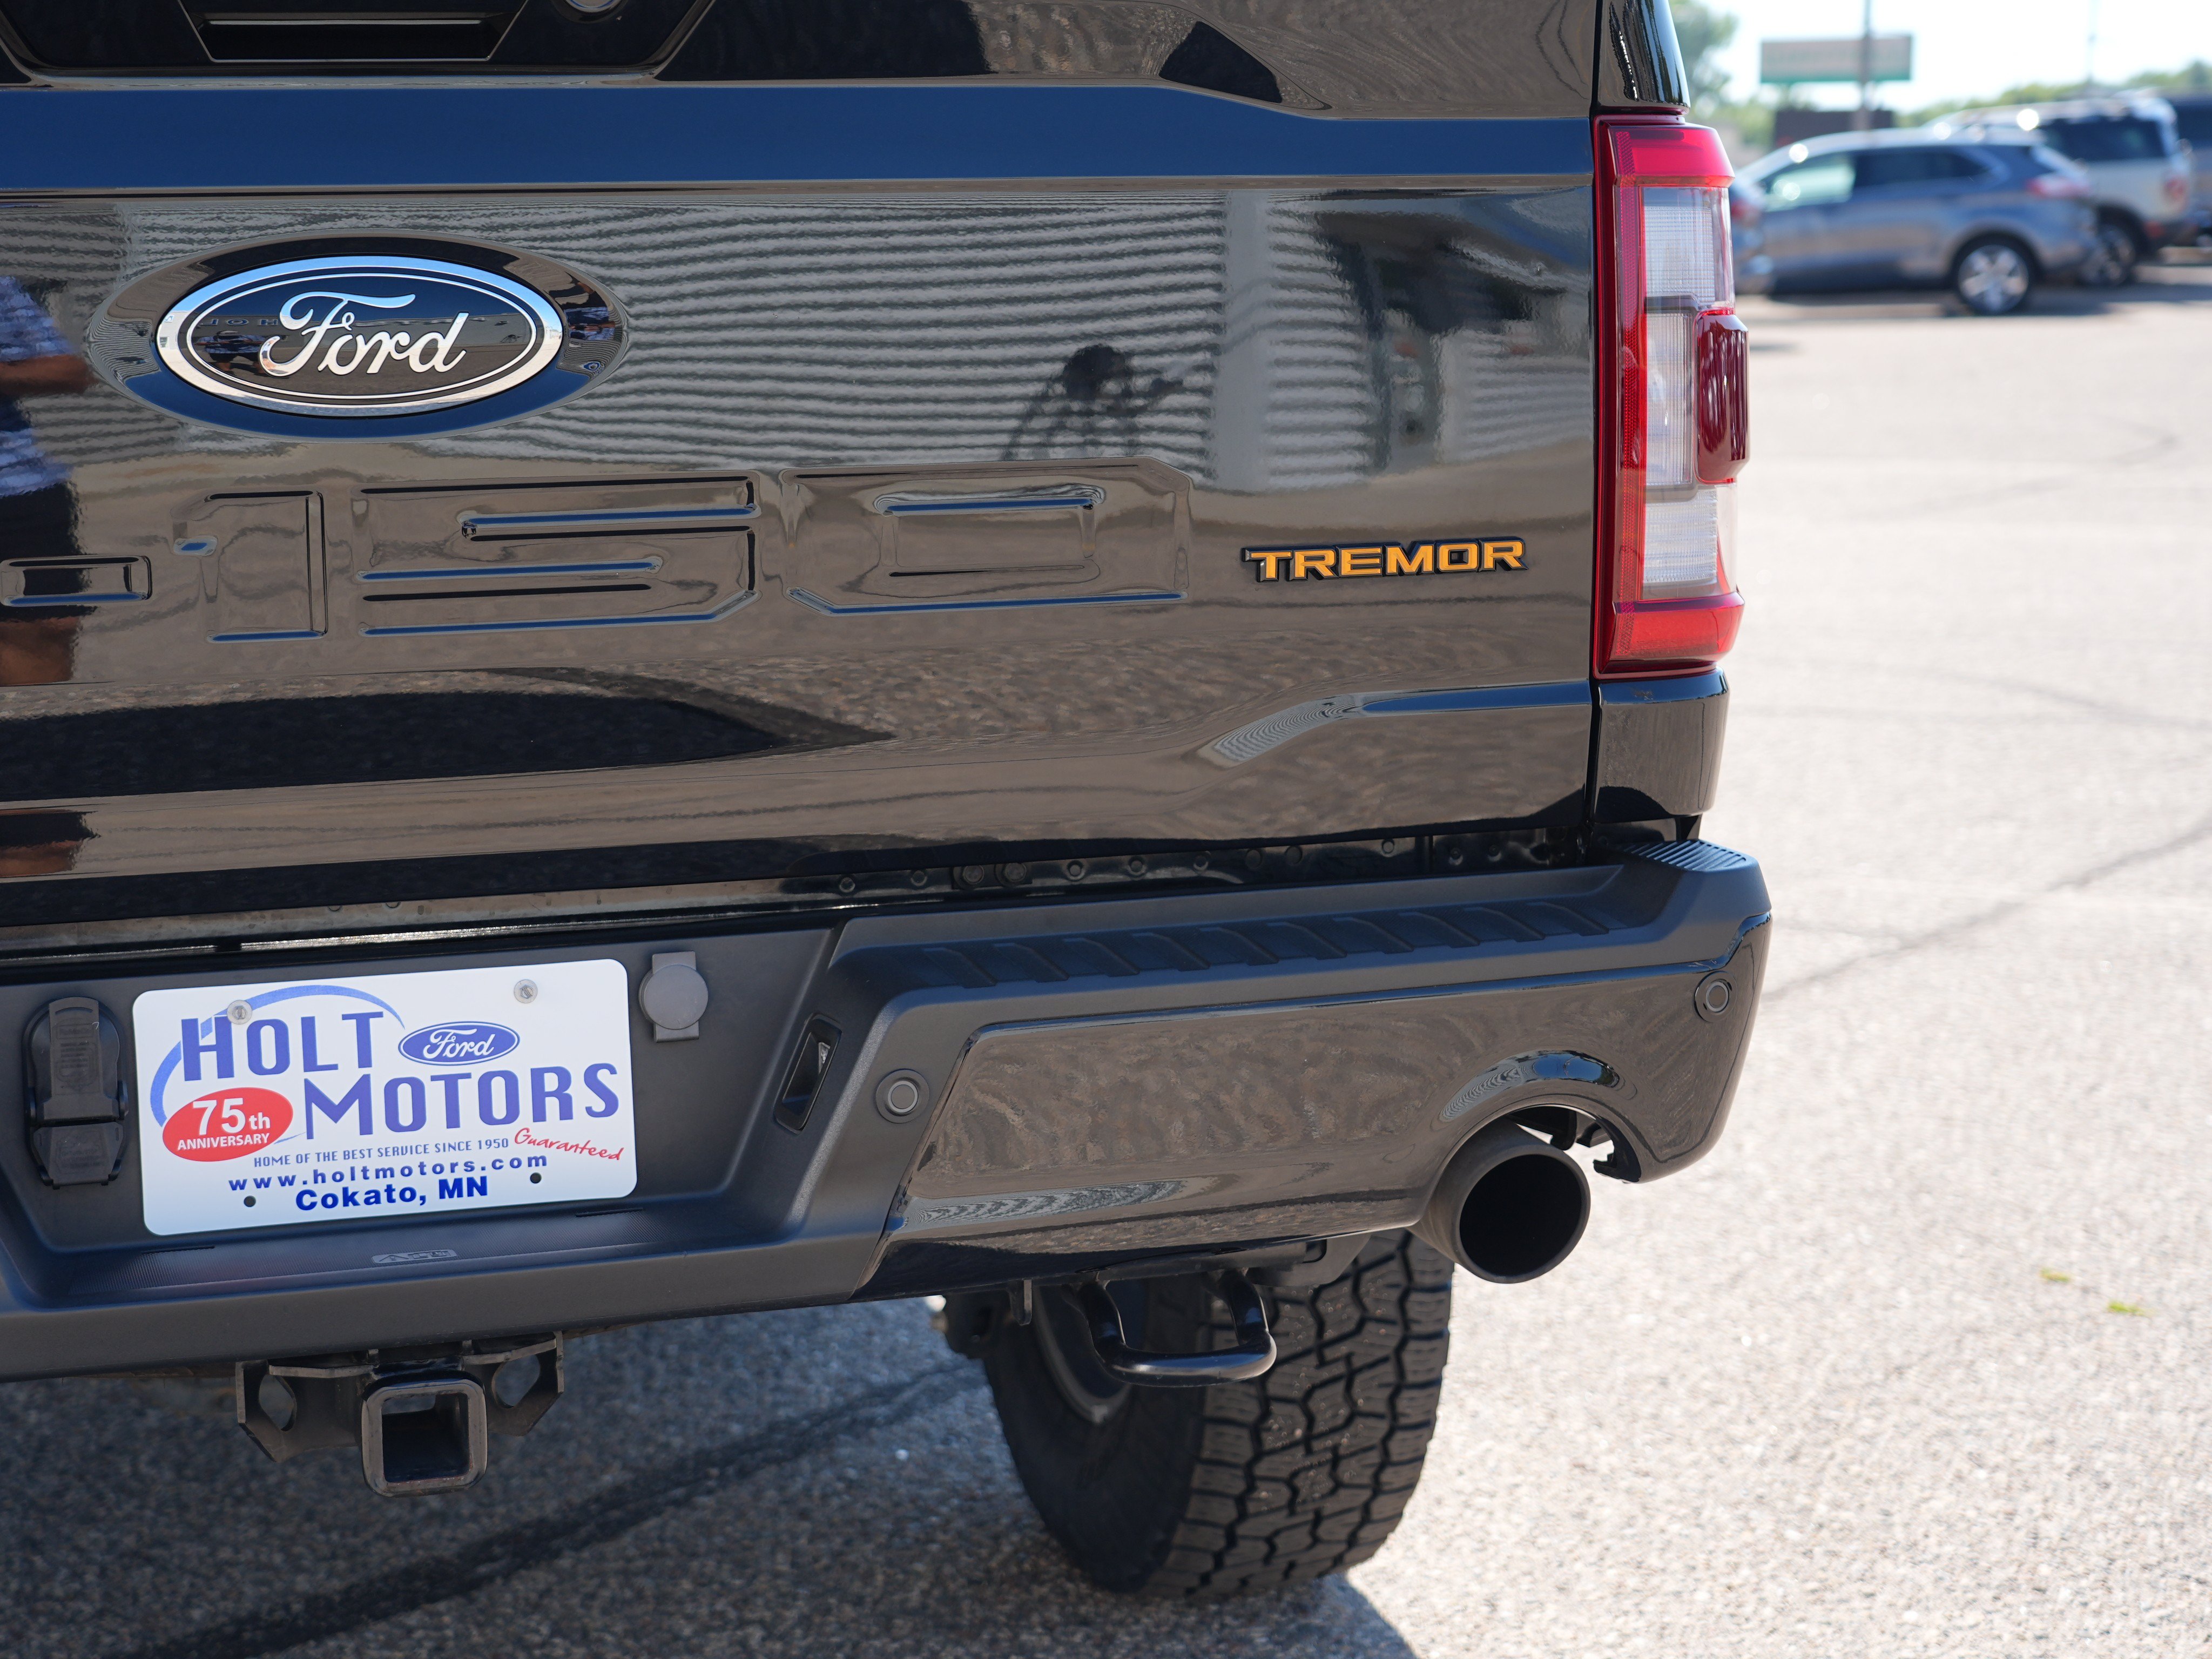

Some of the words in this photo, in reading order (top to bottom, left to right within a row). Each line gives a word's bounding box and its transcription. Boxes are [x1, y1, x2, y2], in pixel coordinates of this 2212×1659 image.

[258, 291, 469, 377] Ford
[1243, 537, 1529, 582] TREMOR
[181, 1011, 383, 1081] HOLT
[423, 1028, 496, 1058] Ford
[192, 1097, 271, 1136] 75th
[304, 1062, 619, 1140] MOTORS
[177, 1132, 270, 1151] ANNIVERSARY
[254, 1155, 291, 1168] HOME
[295, 1153, 311, 1164] OF
[315, 1151, 338, 1162] THE
[343, 1148, 373, 1161] BEST
[377, 1143, 430, 1158] SERVICE
[435, 1141, 473, 1153] SINCE
[477, 1138, 509, 1150] 1950
[514, 1127, 624, 1161] Guaranteed
[228, 1155, 548, 1191] www.holtmotors.com
[295, 1184, 427, 1211] Cokato,
[439, 1175, 488, 1199] MN
